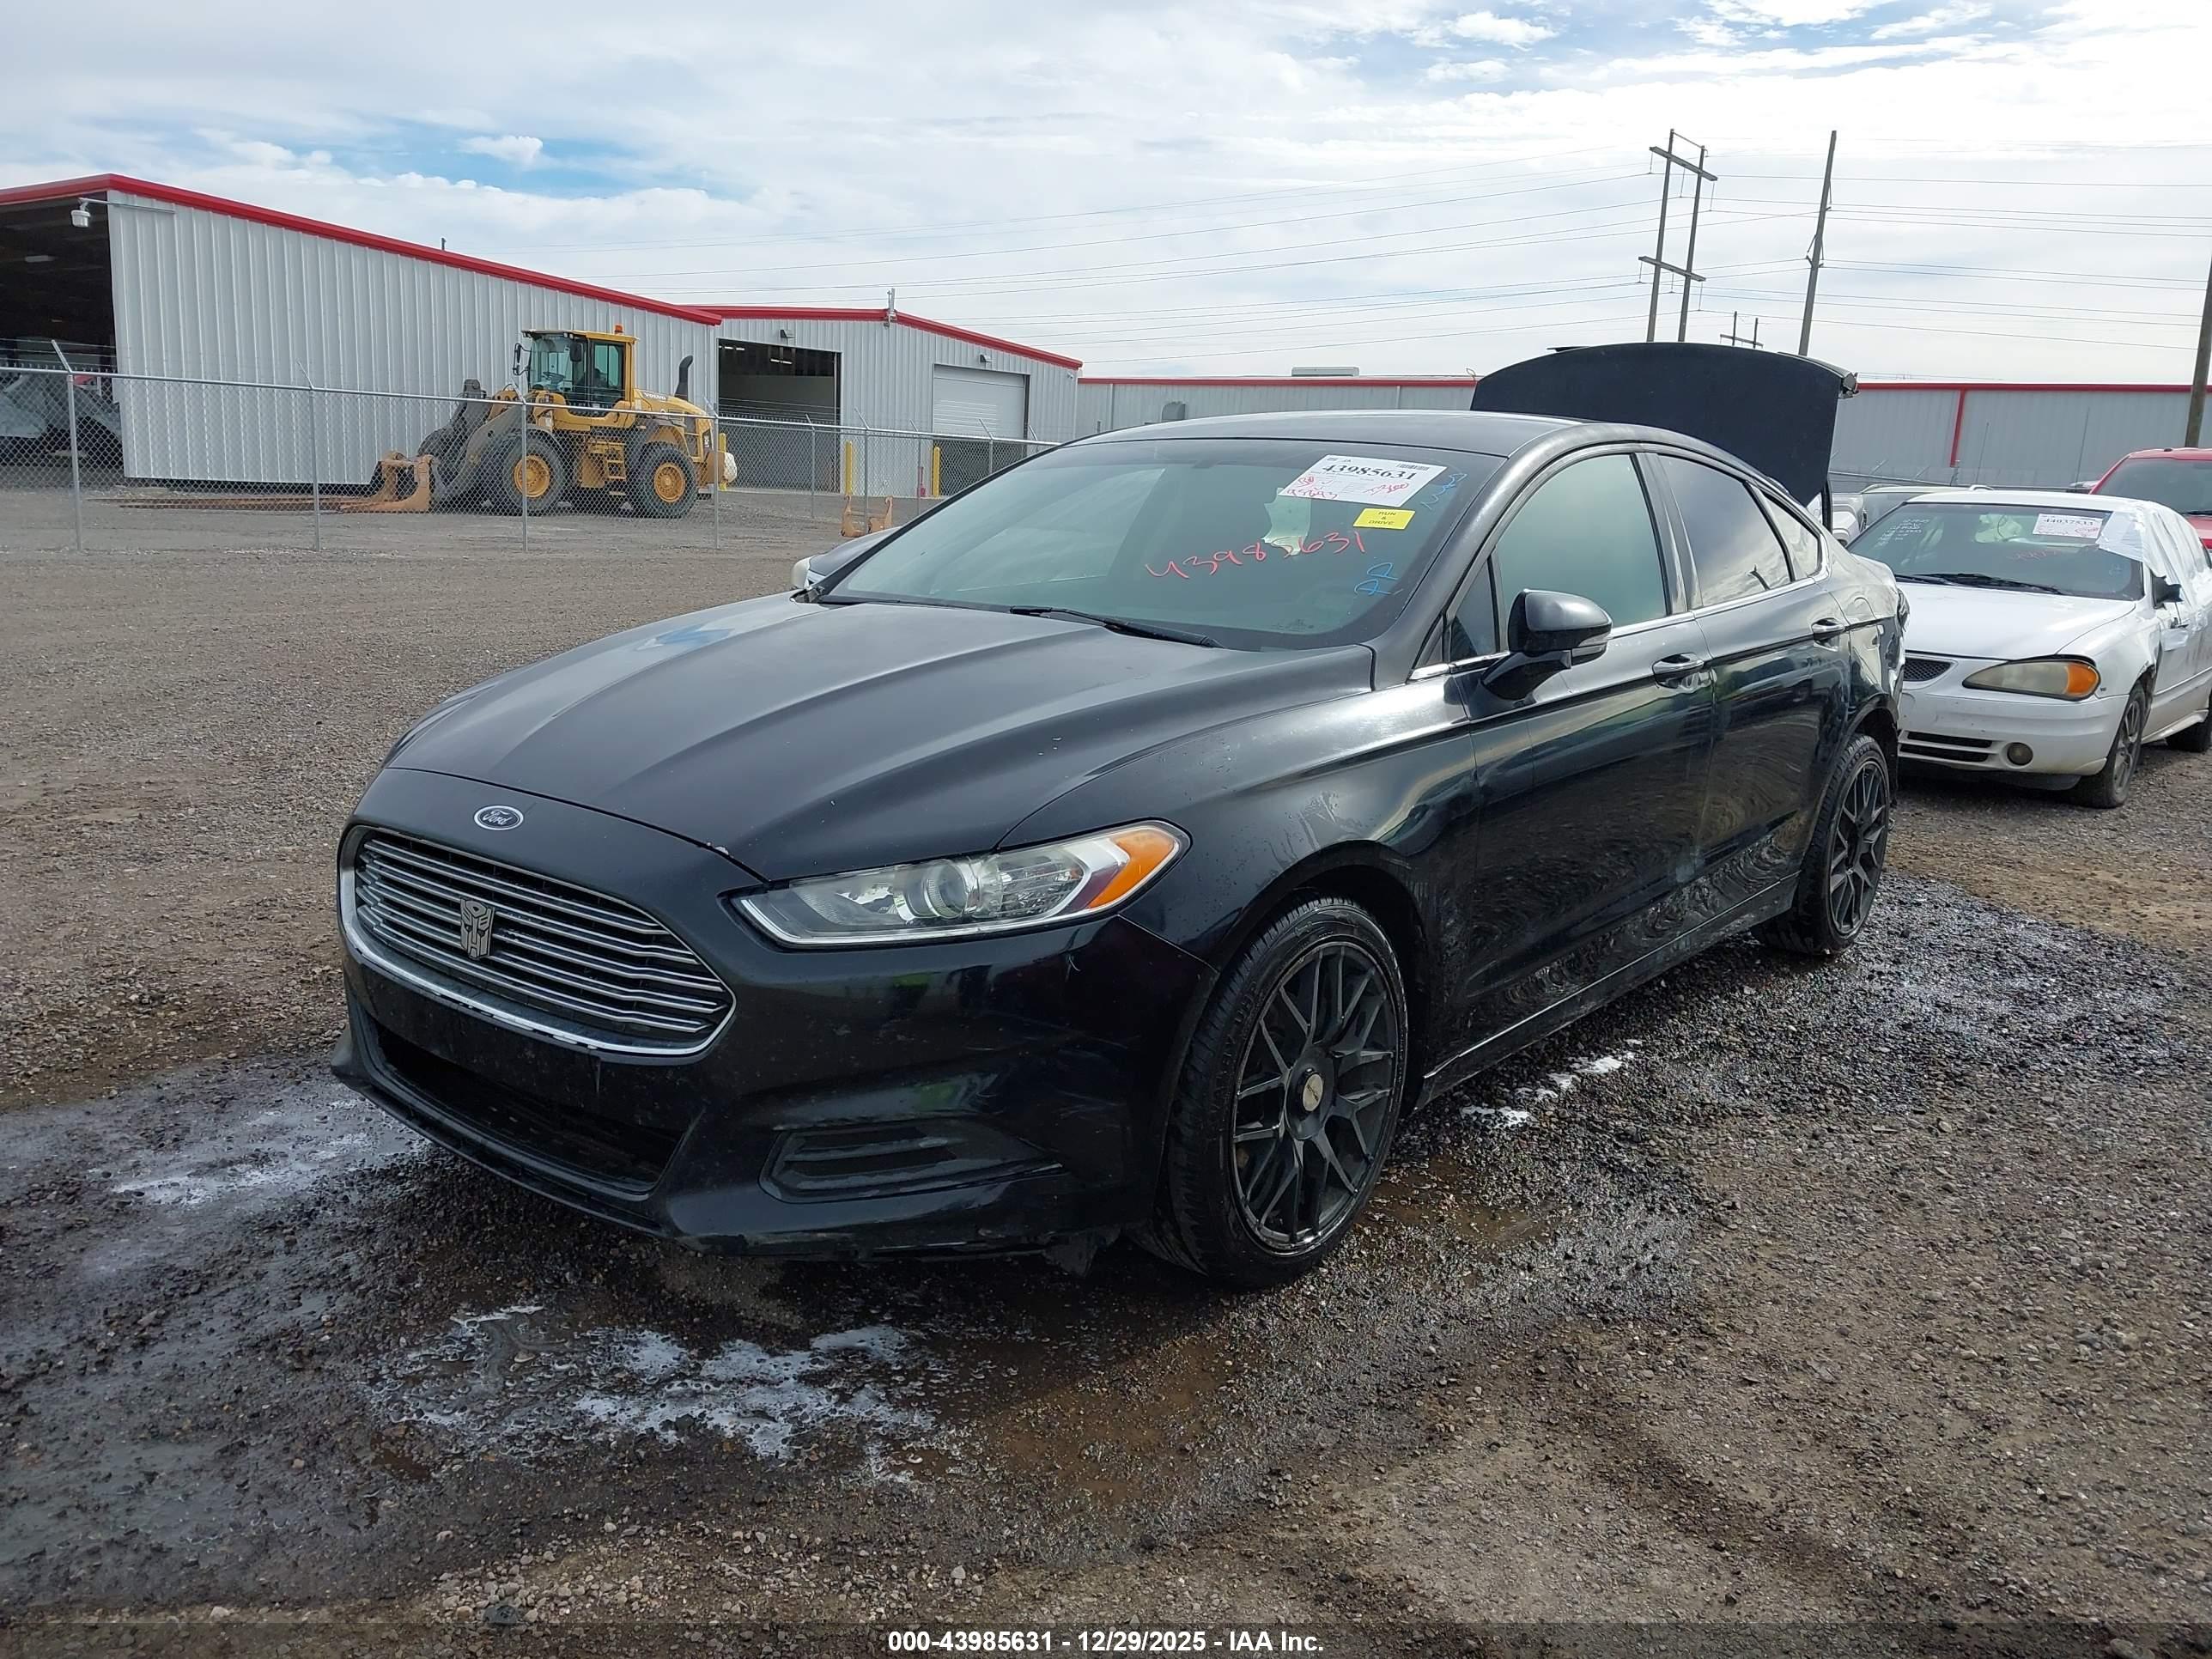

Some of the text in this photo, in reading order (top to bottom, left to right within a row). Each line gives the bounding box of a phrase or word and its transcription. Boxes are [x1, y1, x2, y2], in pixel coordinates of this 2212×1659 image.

[644, 392, 666, 401] VOLVO
[1322, 464, 1417, 481] 43985631
[483, 809, 512, 825] Ford
